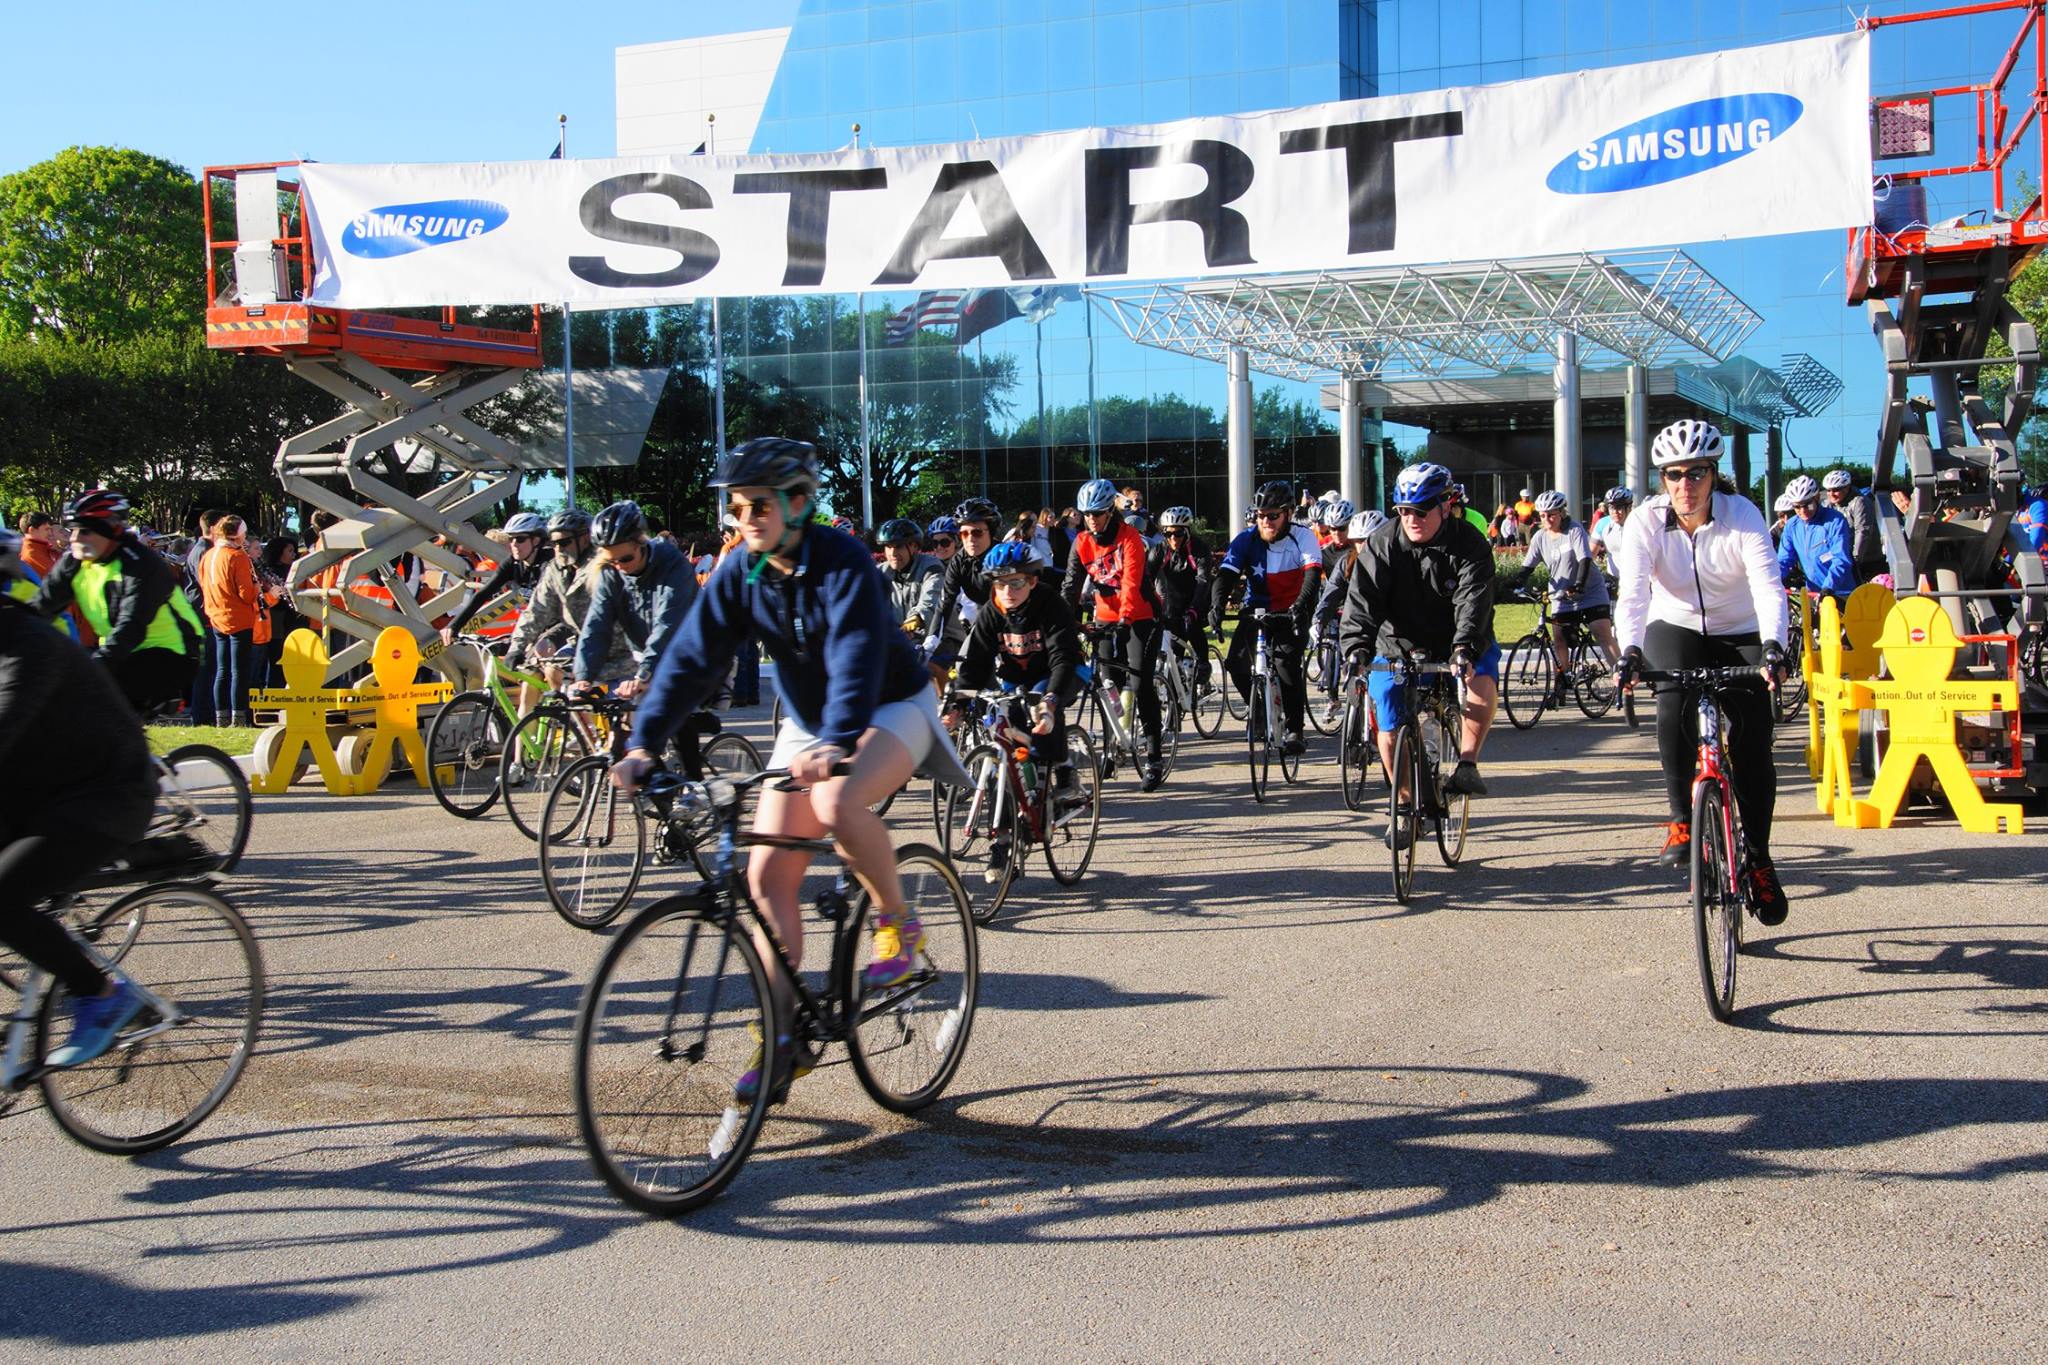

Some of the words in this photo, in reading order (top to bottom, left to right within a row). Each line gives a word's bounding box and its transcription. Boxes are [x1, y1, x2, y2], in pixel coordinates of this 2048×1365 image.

[1577, 118, 1771, 171] SAMSUNG
[568, 111, 1464, 288] START
[353, 213, 485, 239] SAMSUNG
[421, 639, 445, 660] KEEP
[309, 695, 315, 703] of
[401, 691, 408, 699] of
[409, 690, 432, 699] Service
[1927, 691, 1936, 701] of
[1940, 691, 1977, 701] Service
